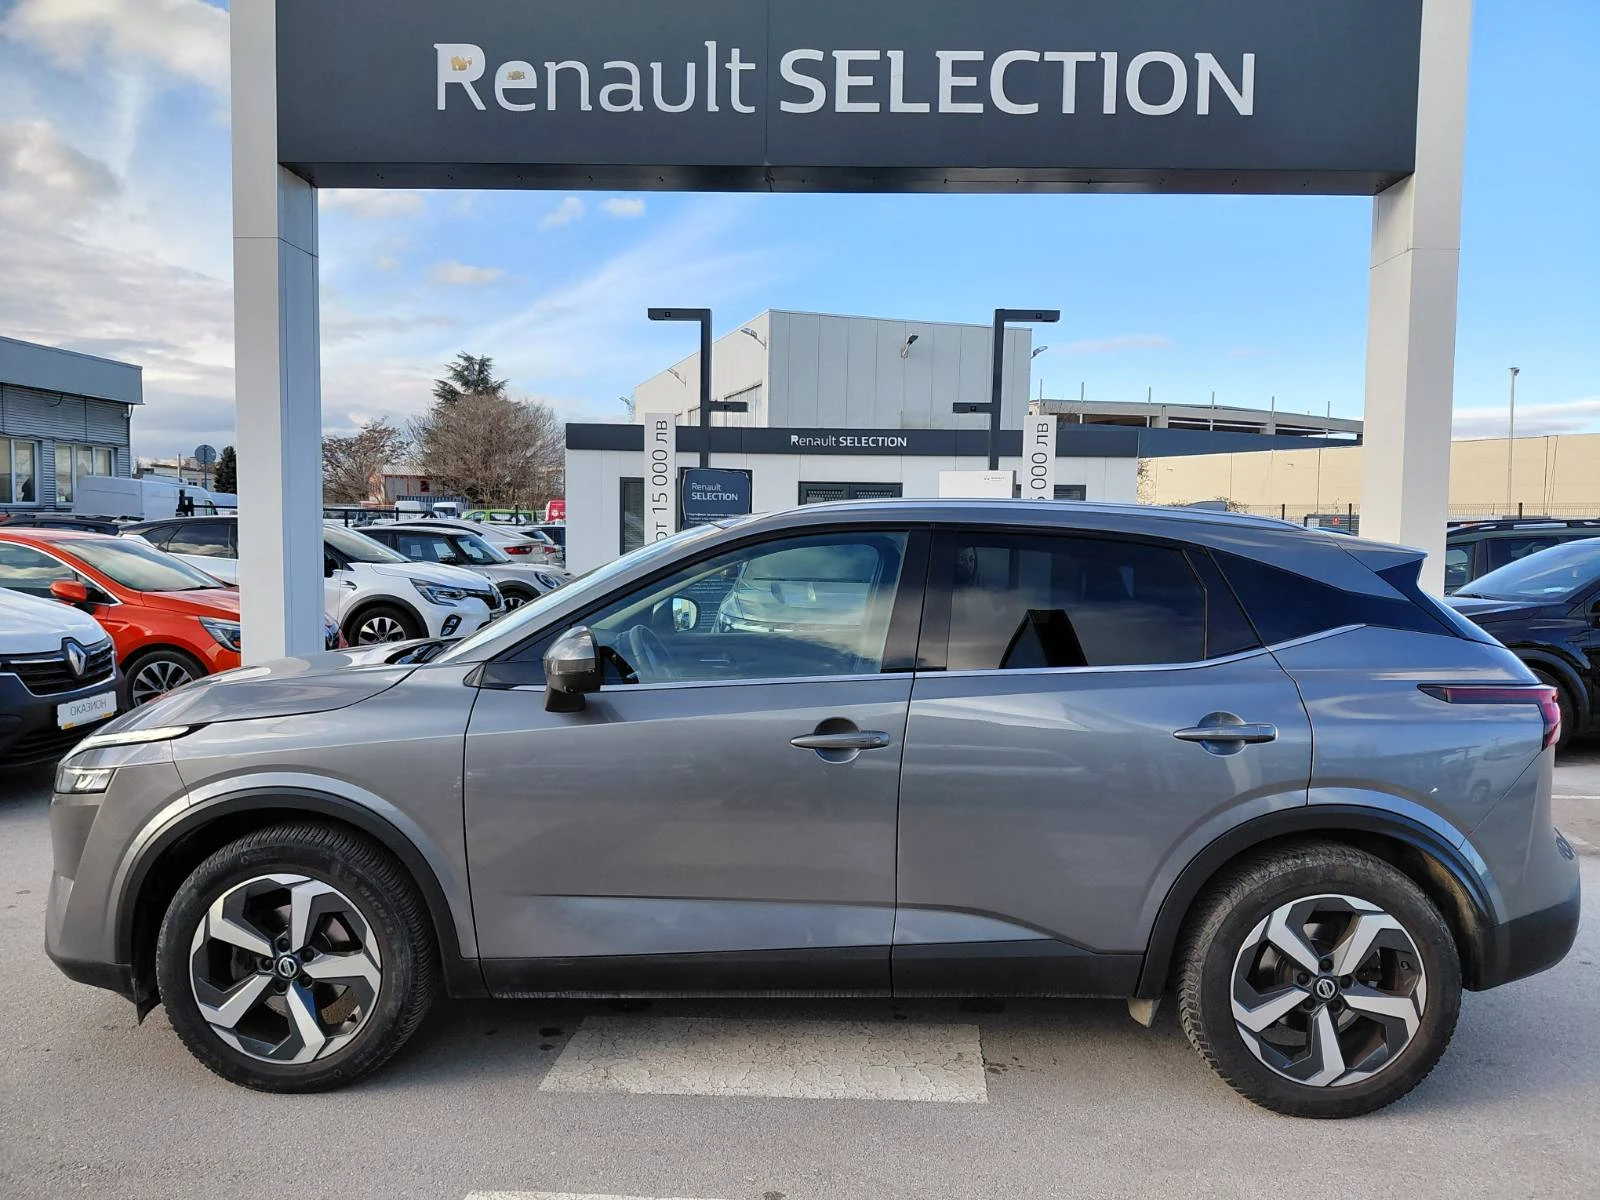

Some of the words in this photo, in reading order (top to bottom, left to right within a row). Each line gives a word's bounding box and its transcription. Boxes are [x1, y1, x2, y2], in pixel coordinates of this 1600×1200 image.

[433, 40, 757, 114] Renault
[779, 48, 1256, 116] SELECTION
[790, 434, 837, 447] Renault
[839, 436, 907, 448] SELECTION
[651, 449, 668, 486] 000
[691, 482, 722, 492] Renault
[651, 493, 668, 514] 15
[691, 492, 739, 501] SELECTION
